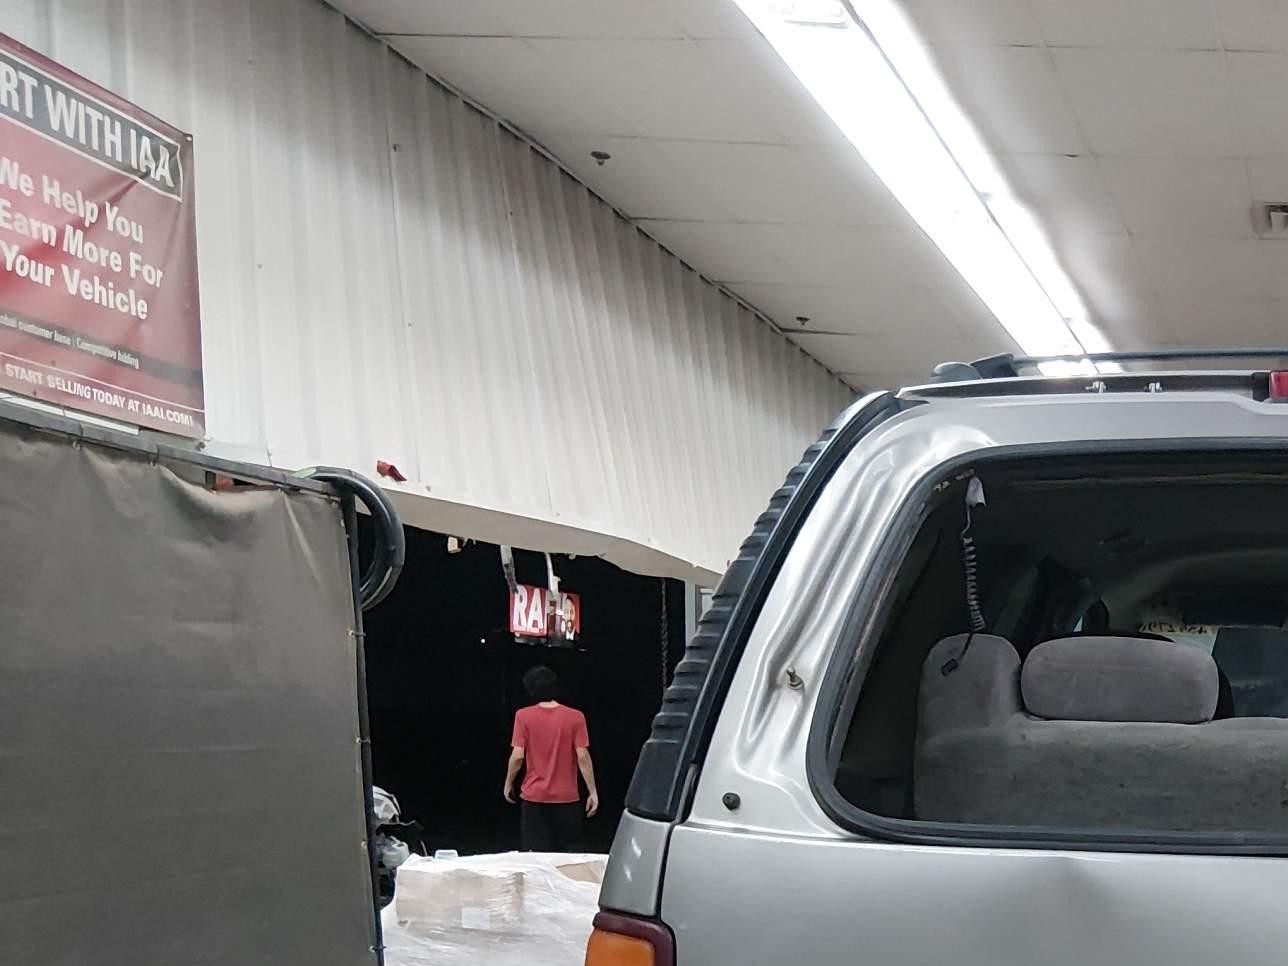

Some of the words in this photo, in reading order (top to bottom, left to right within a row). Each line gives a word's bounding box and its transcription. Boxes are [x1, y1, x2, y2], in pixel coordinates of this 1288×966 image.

[44, 84, 122, 162] WITH
[130, 128, 175, 188] IAA
[0, 198, 56, 246] Earn
[63, 224, 122, 273] More
[129, 251, 163, 287] For
[42, 175, 99, 227] Help
[105, 201, 144, 244] You
[0, 239, 54, 287] Your
[61, 263, 148, 320] Vehicle
[54, 329, 71, 345] base
[5, 363, 43, 385] START
[46, 374, 91, 400] SELLING
[92, 387, 126, 409] TODAY
[128, 400, 140, 414] AT
